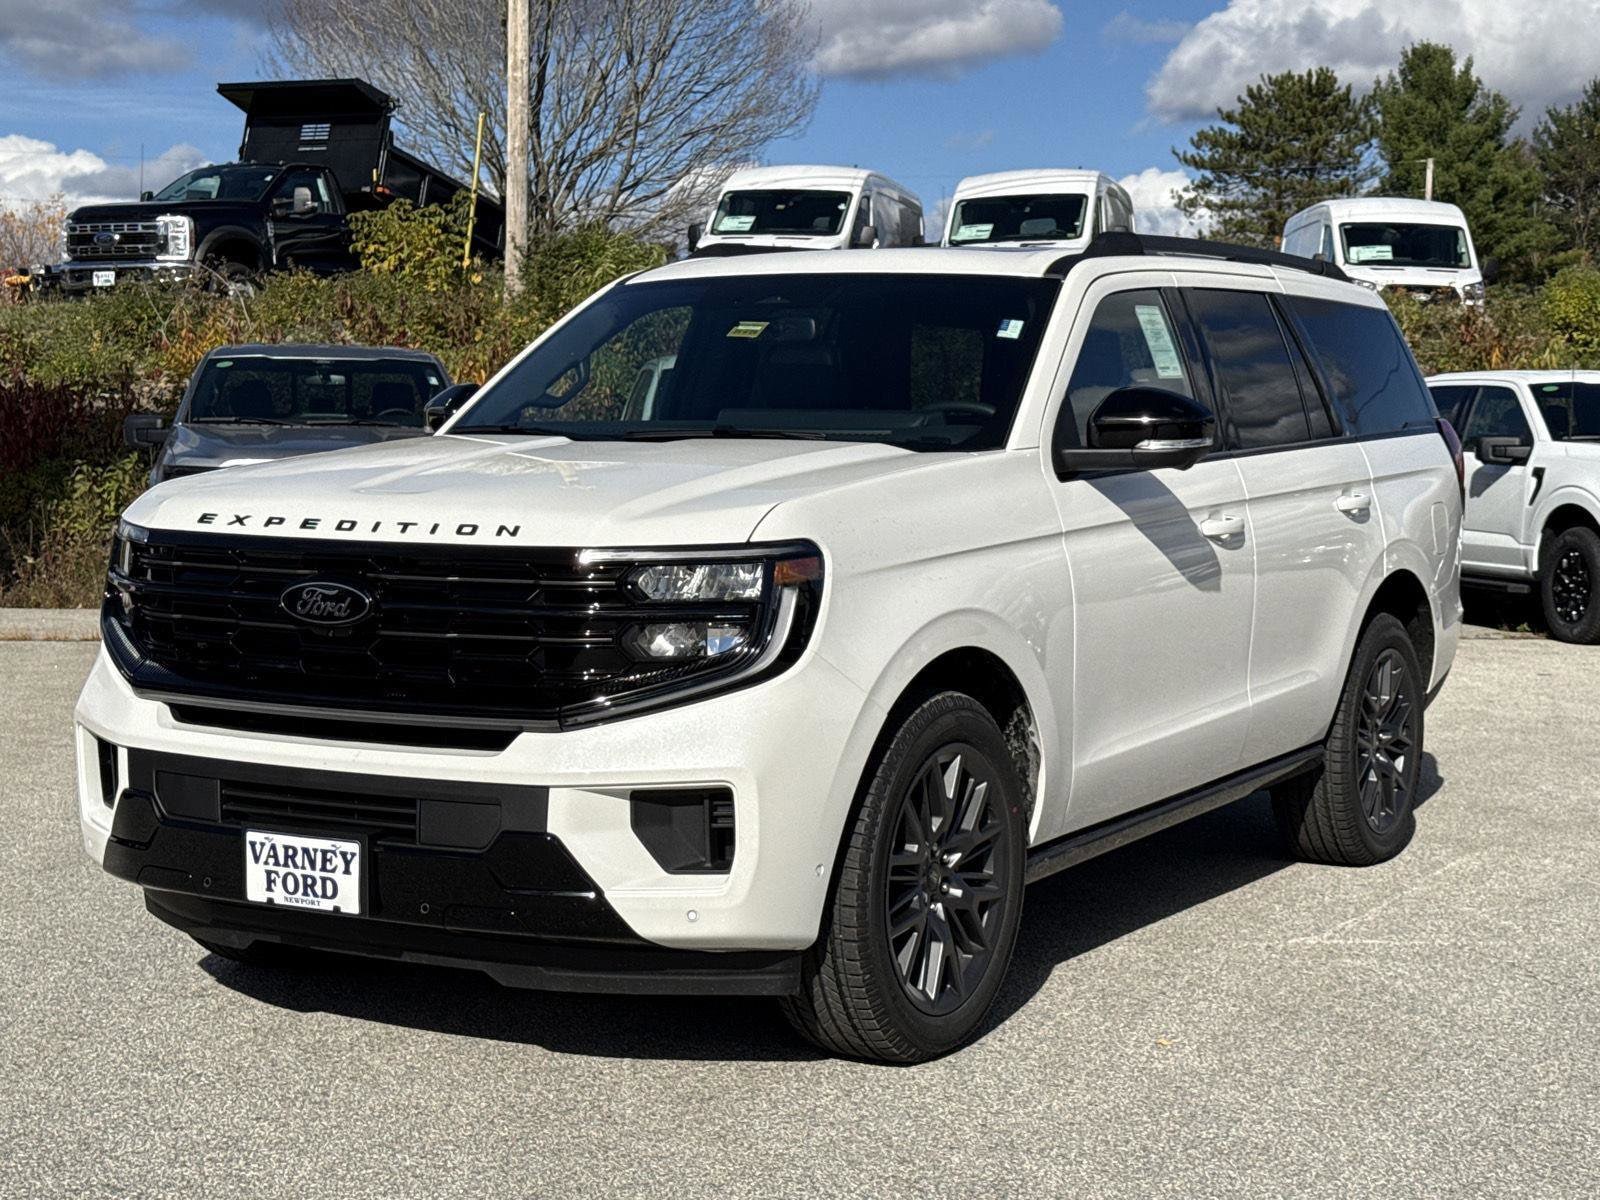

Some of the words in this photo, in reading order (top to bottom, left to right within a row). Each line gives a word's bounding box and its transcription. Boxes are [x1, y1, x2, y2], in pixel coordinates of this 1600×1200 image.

[197, 512, 521, 538] EXPEDITION
[297, 586, 351, 618] Ford
[248, 840, 357, 875] VARNEY
[264, 869, 339, 900] FORD
[283, 895, 321, 907] NEWPORT
